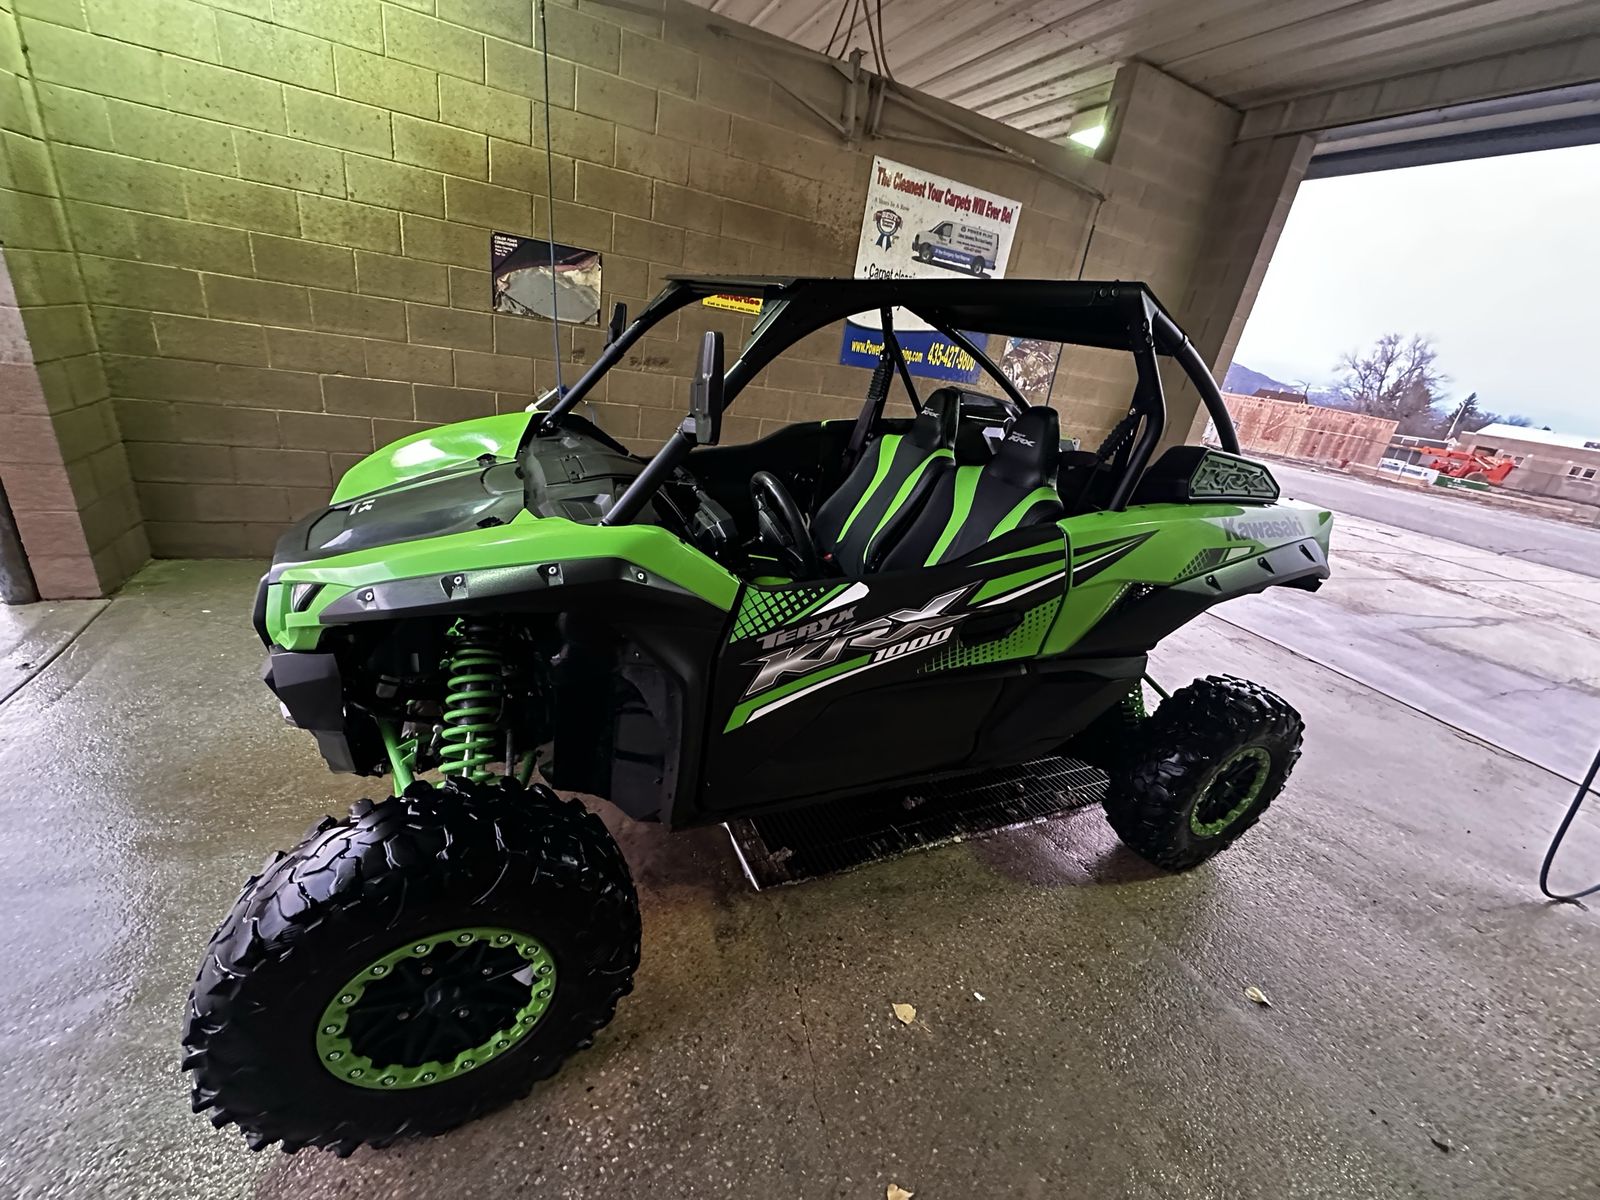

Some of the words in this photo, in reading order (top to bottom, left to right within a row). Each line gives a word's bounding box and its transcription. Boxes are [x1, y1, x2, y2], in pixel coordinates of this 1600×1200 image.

[877, 166, 892, 188] The
[893, 171, 927, 199] Cleanest
[928, 182, 944, 203] Your
[944, 188, 972, 212] Carpets
[972, 196, 987, 216] Will
[985, 201, 1001, 221] Ever
[1222, 516, 1306, 542] Kawasaki
[740, 580, 983, 702] KRX
[756, 605, 857, 650] TERYX
[873, 626, 954, 662] 1000
